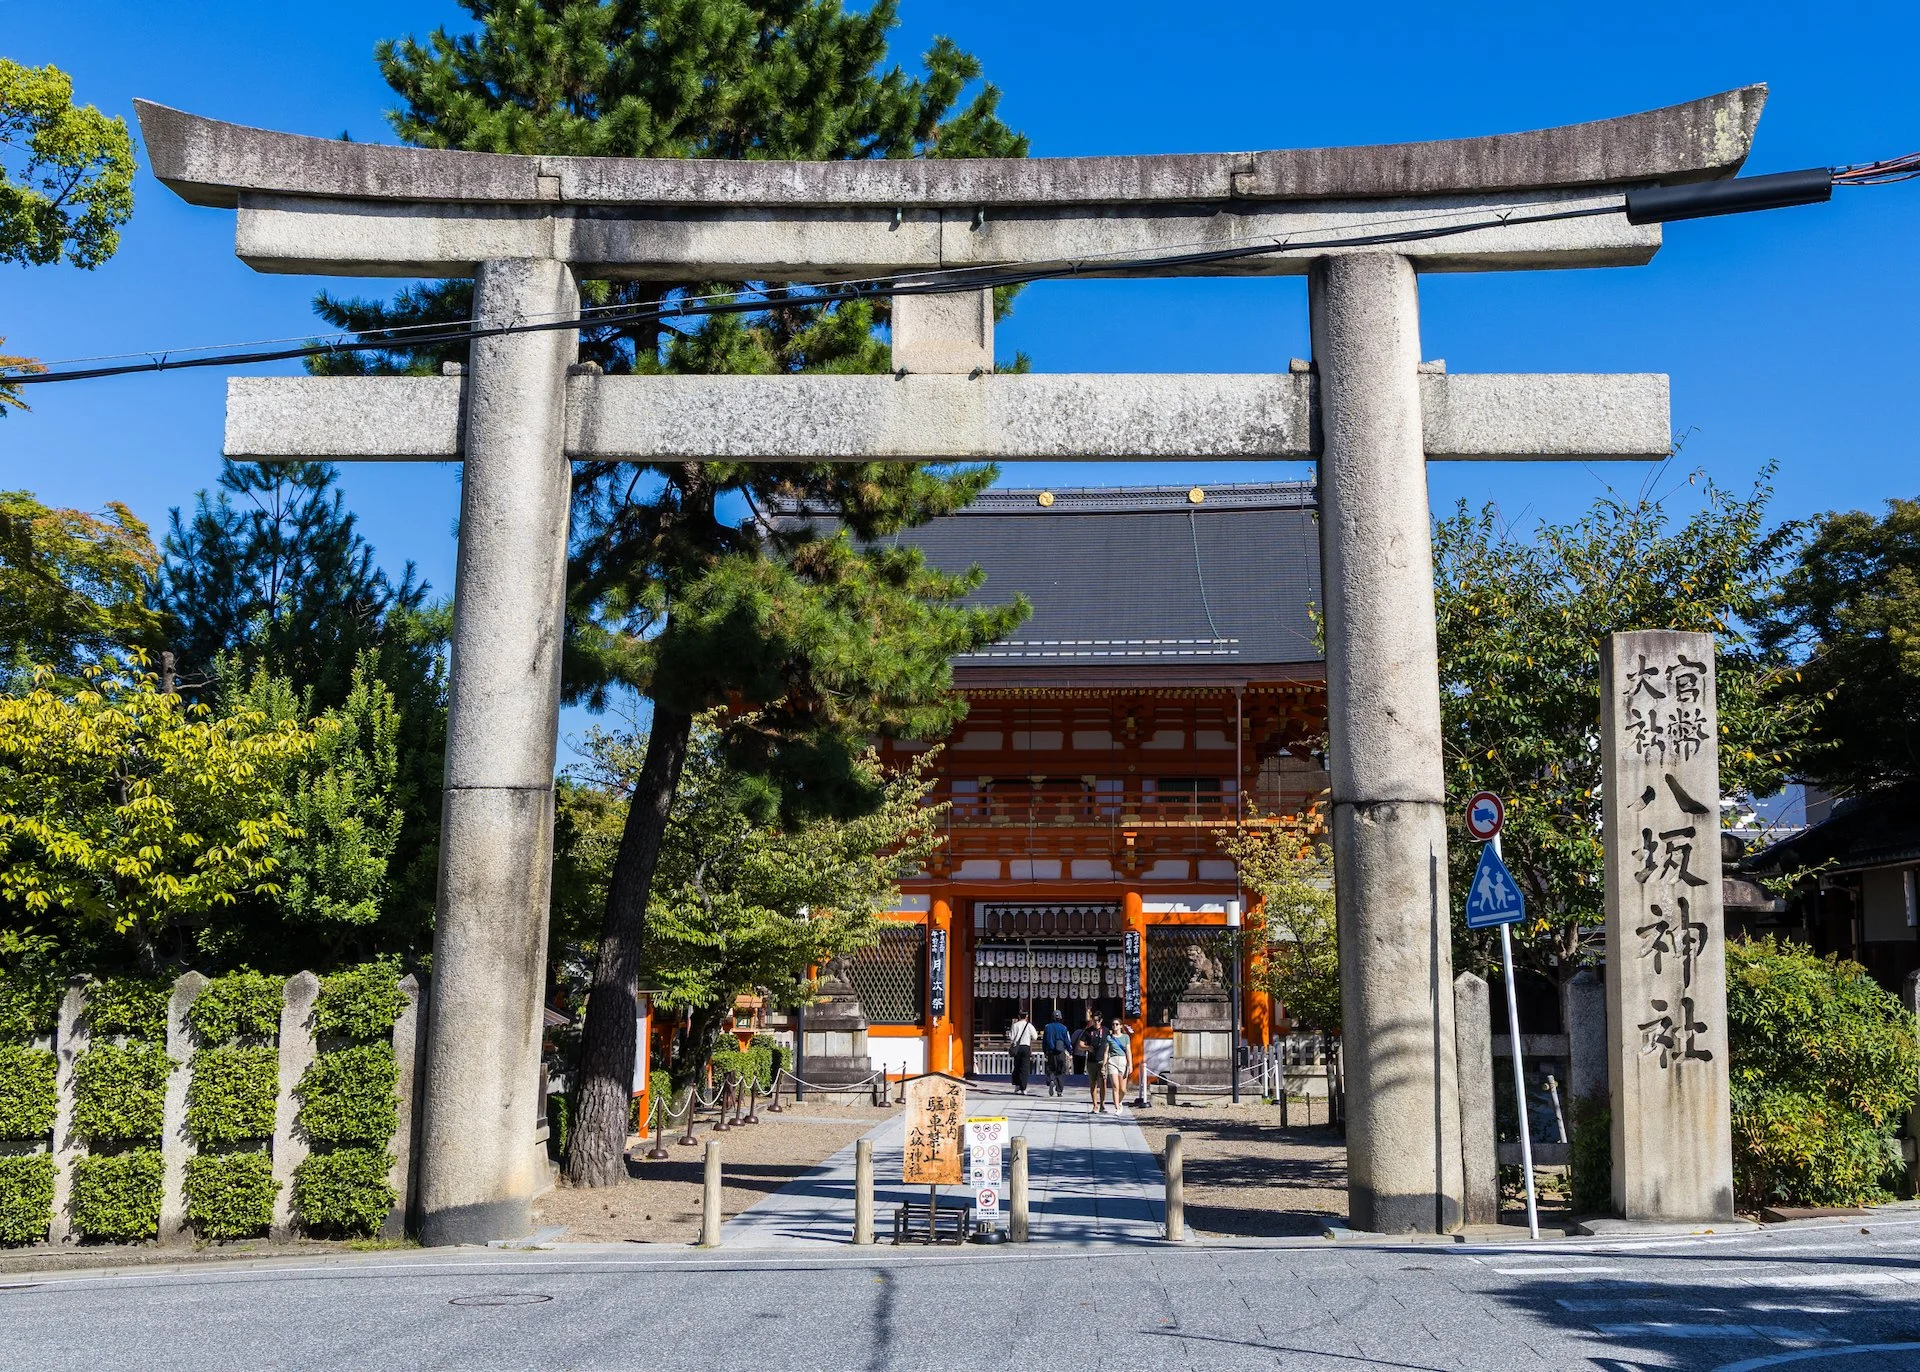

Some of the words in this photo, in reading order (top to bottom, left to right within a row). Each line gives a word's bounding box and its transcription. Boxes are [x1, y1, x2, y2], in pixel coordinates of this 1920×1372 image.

[1622, 654, 1666, 757] 大社
[1627, 772, 1713, 1068] 八坂神社
[932, 959, 944, 1010] 月次祭
[909, 1126, 925, 1178] 八坂神社
[924, 1096, 945, 1163] 駐車禁止
